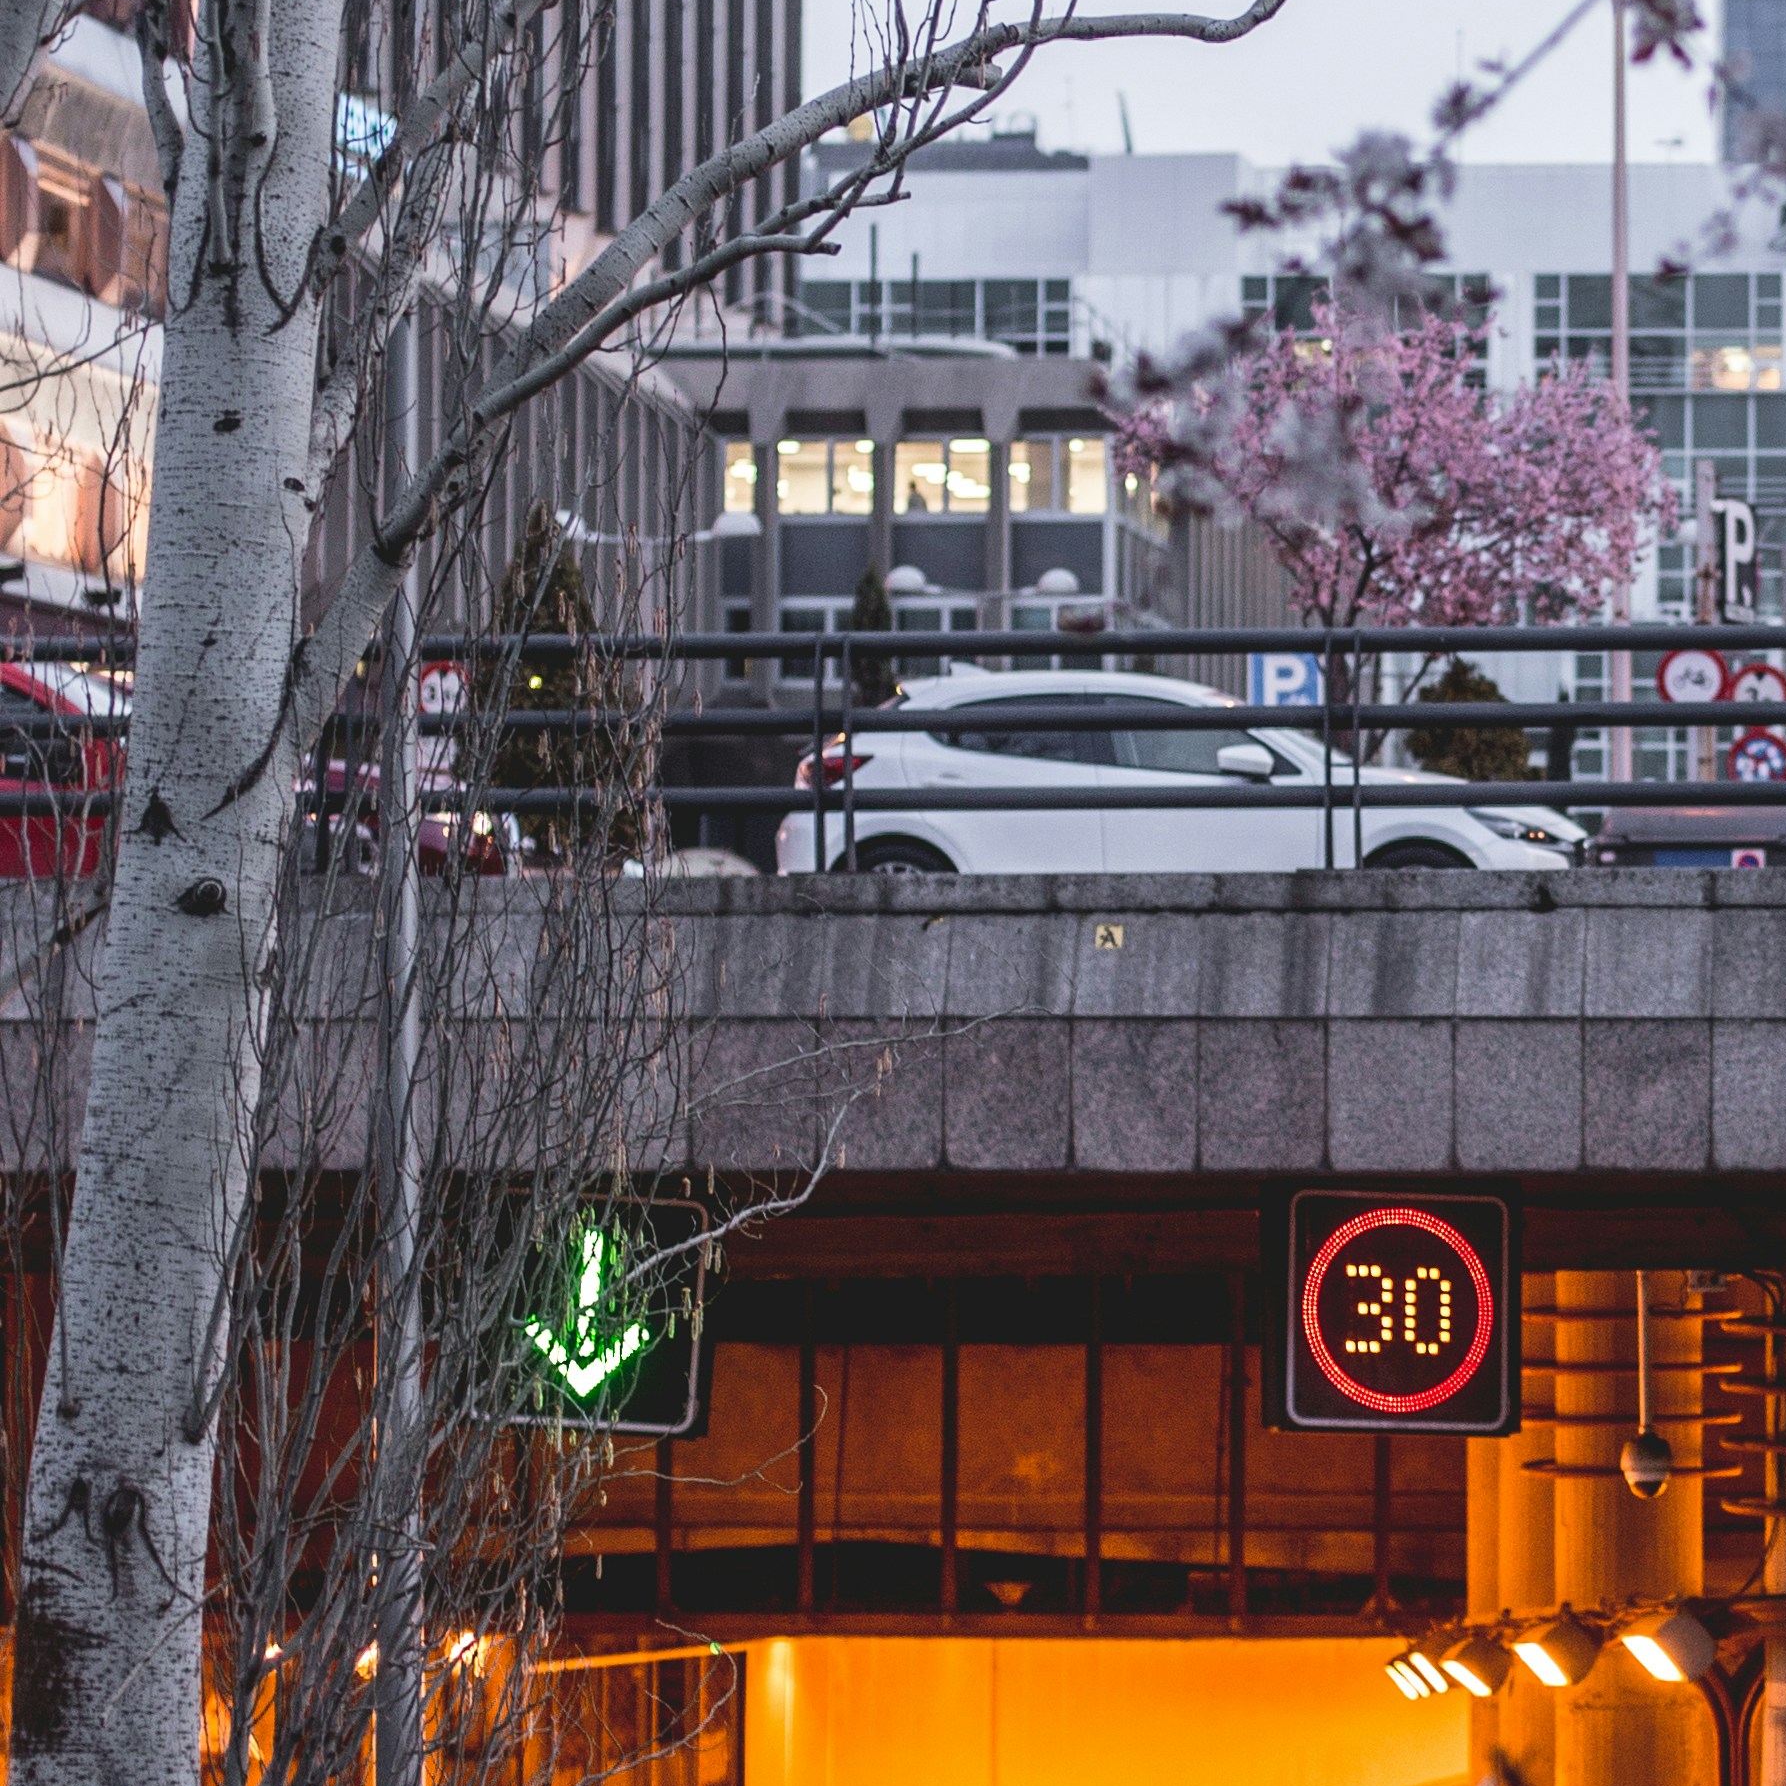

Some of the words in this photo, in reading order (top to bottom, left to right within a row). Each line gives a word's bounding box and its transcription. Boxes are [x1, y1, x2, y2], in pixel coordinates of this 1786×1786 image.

[1724, 499, 1755, 604] P
[1263, 652, 1307, 706] P
[1345, 1263, 1452, 1355] 30
